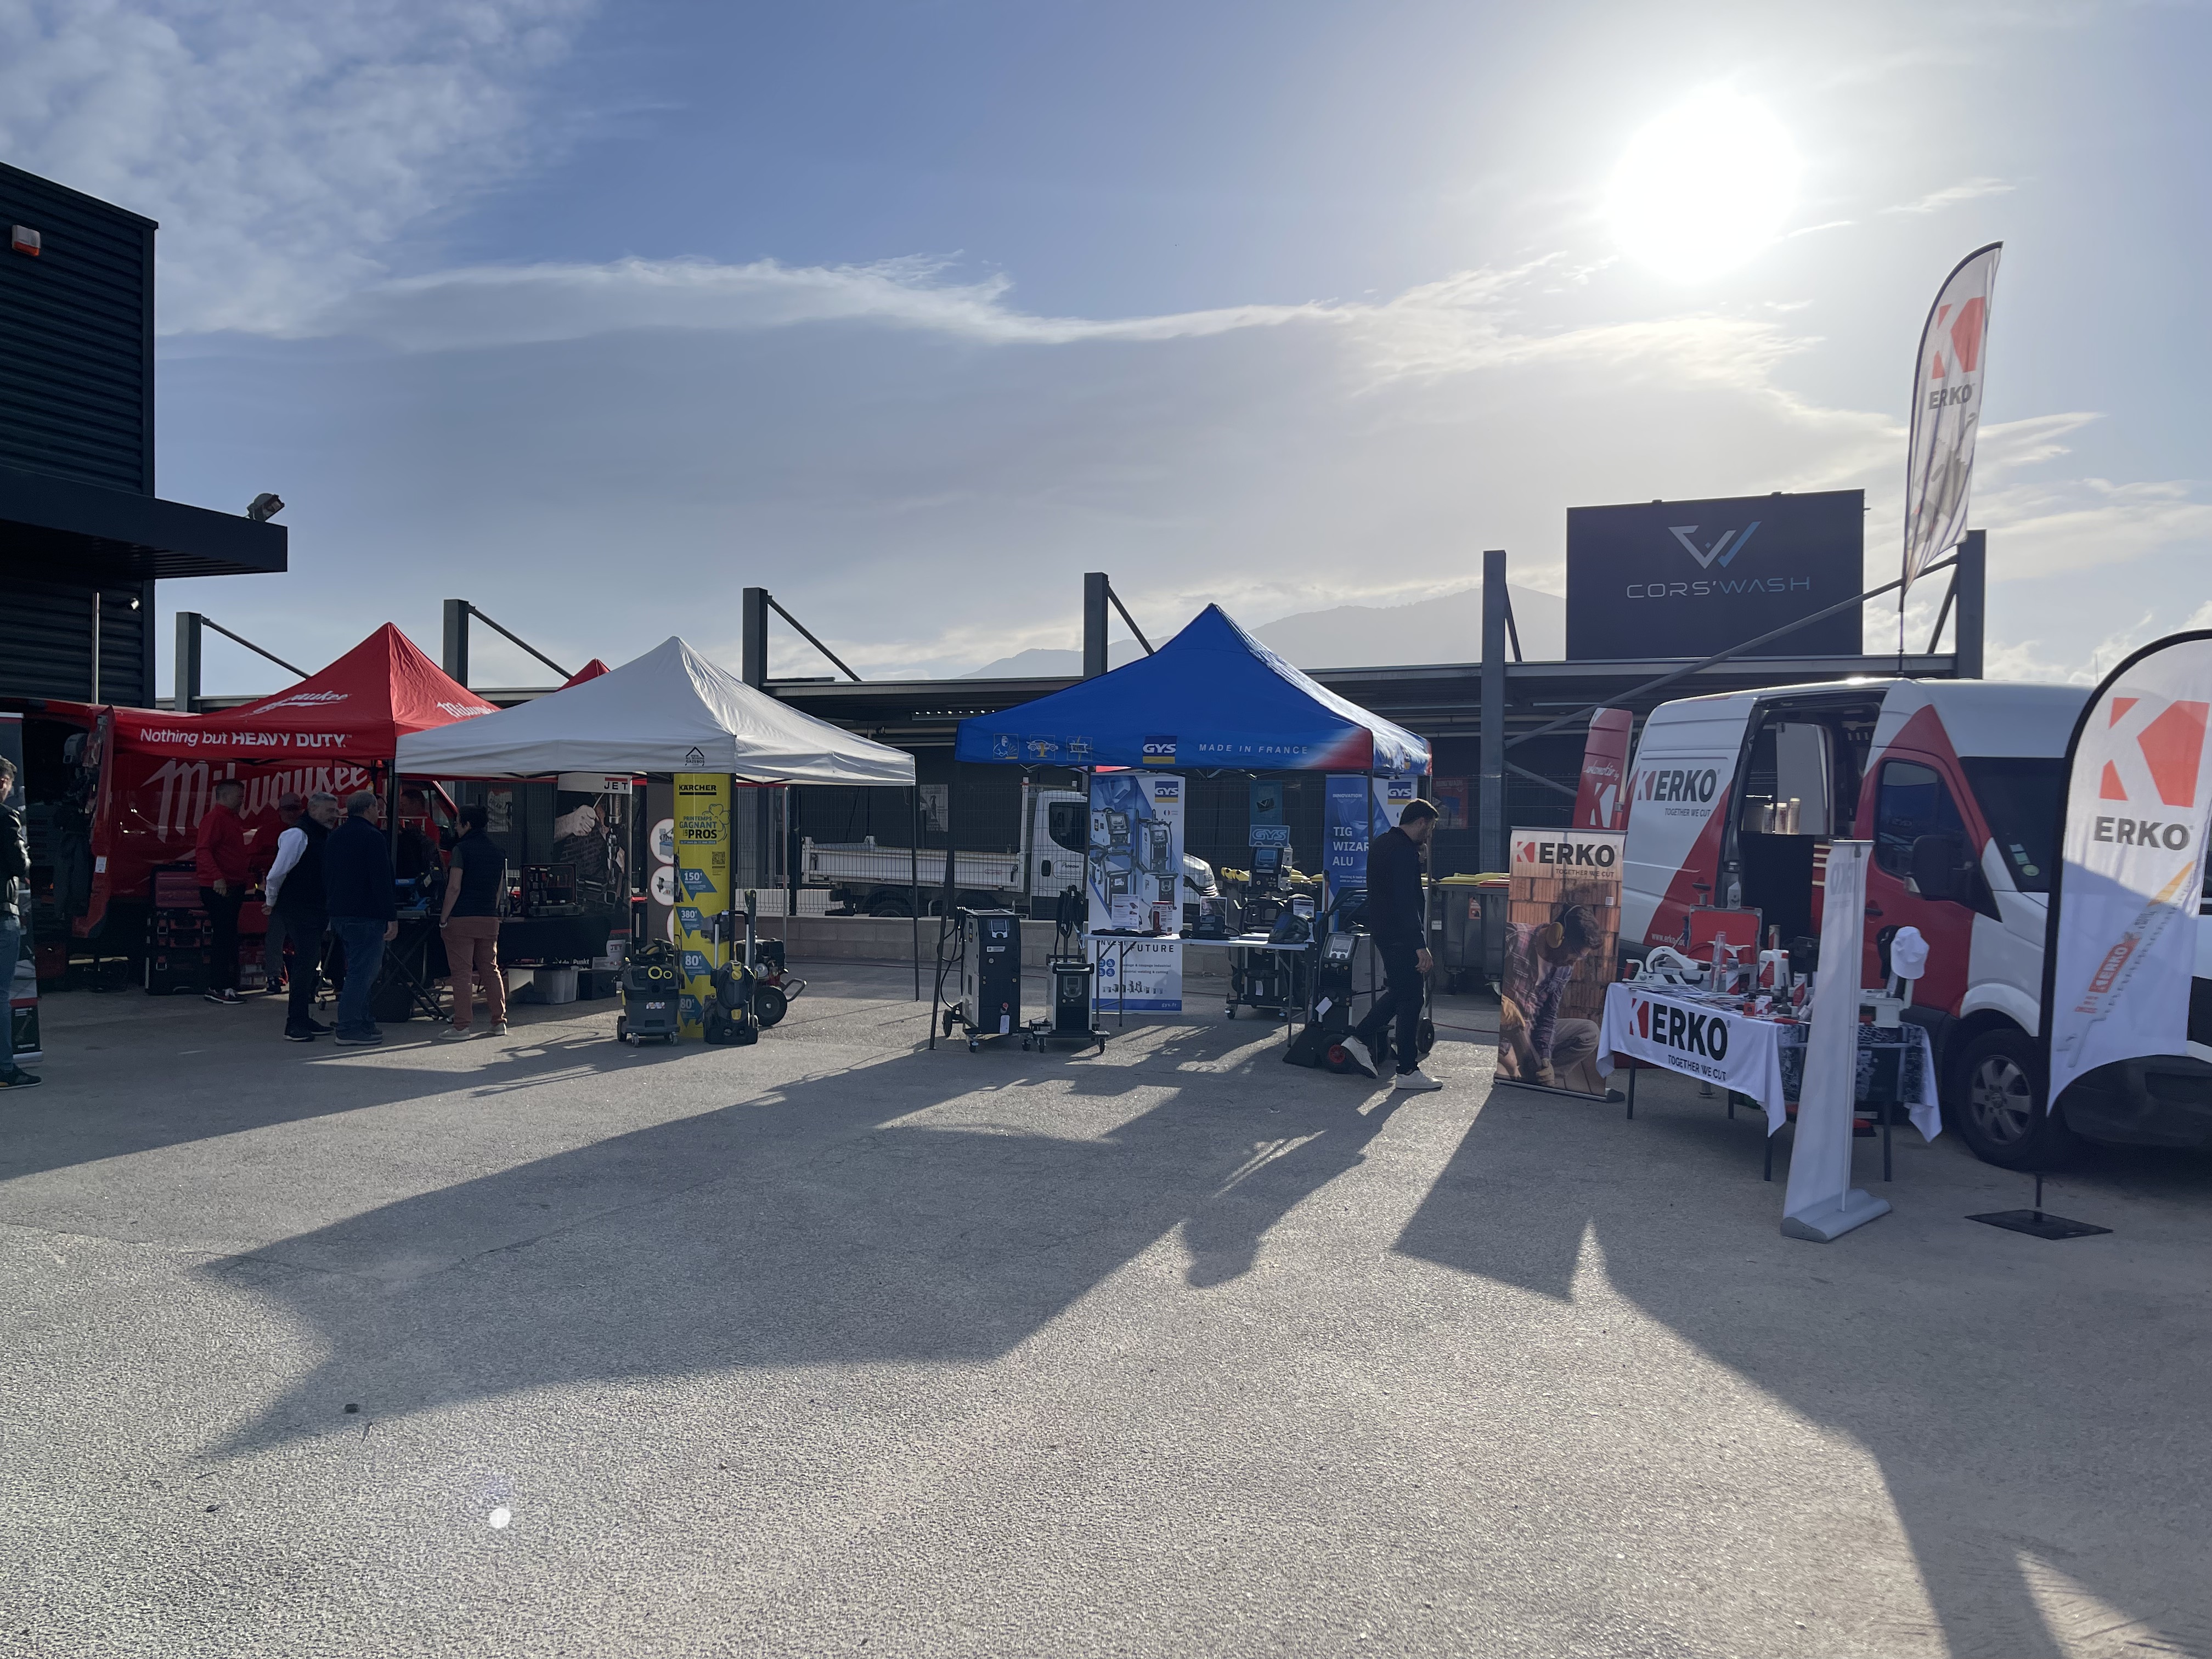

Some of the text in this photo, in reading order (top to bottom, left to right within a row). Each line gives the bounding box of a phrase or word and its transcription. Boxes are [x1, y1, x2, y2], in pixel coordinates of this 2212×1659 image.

[1928, 384, 1973, 410] ERKO
[1626, 577, 1810, 599] CORS'WASH
[140, 728, 198, 747] Nothing
[202, 731, 228, 744] but
[232, 732, 290, 747] HEAVY
[1143, 743, 1177, 753] GYS
[1199, 744, 1232, 752] MADE
[1259, 746, 1308, 754] FRANCE
[604, 782, 628, 790] JET
[1155, 787, 1178, 795] GYS
[1387, 788, 1412, 797] GYS
[140, 758, 369, 844] Miwaukee
[1664, 808, 1690, 816] TOGETHER
[1700, 809, 1711, 817] CUT
[688, 829, 717, 839] PROS
[1252, 828, 1287, 840] GYS
[1333, 827, 1352, 836] TIG
[2094, 816, 2191, 851] ERKO
[1333, 842, 1369, 851] WIZAR
[1332, 856, 1353, 866] ALU
[1668, 1054, 1726, 1081] TOGETHER WE CUT
